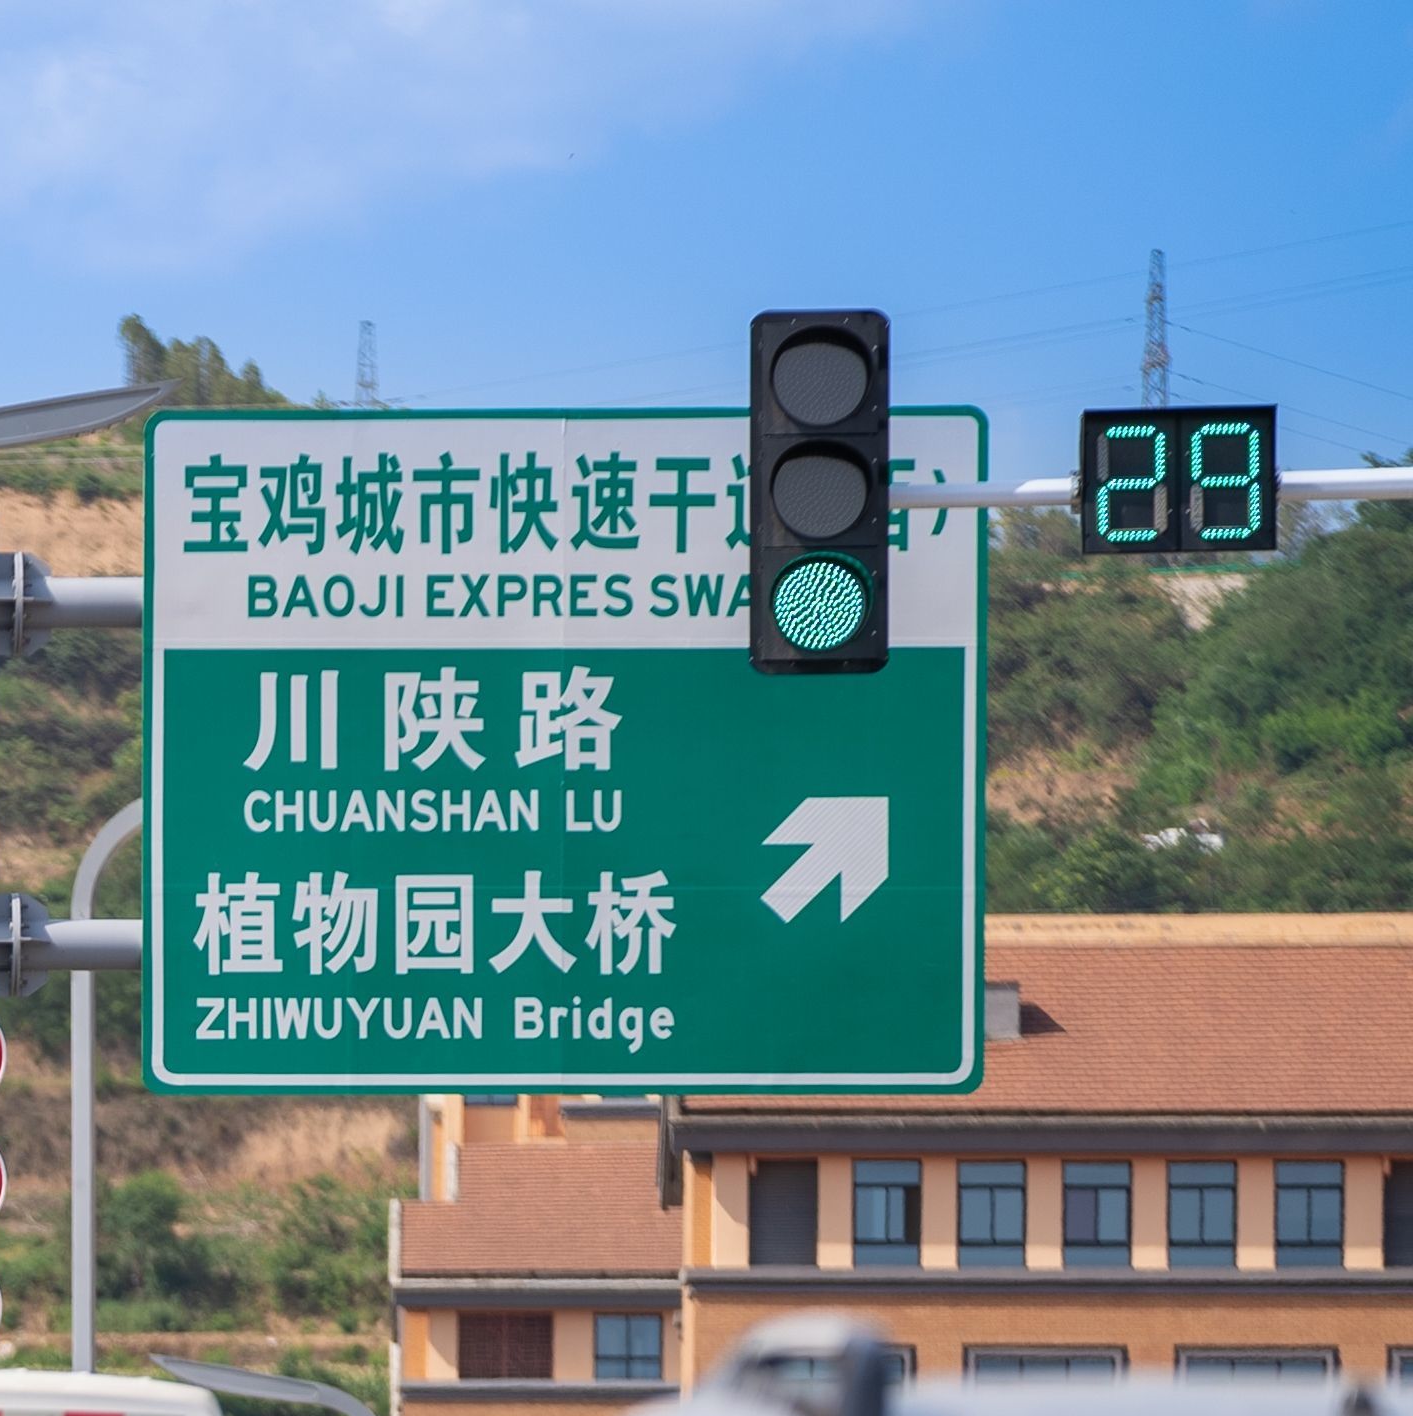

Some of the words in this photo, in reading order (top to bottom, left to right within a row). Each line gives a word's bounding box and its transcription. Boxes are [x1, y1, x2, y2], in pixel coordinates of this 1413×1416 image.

[1095, 422, 1262, 543] 29
[247, 574, 405, 619] BAOJI
[243, 666, 623, 772] 川陕路
[243, 789, 541, 834] CHUANSHAN
[566, 789, 624, 833] LU
[193, 870, 678, 977] 植物园大桥
[195, 997, 485, 1041] ZHIWUYUAN
[514, 996, 677, 1054] Bridge
